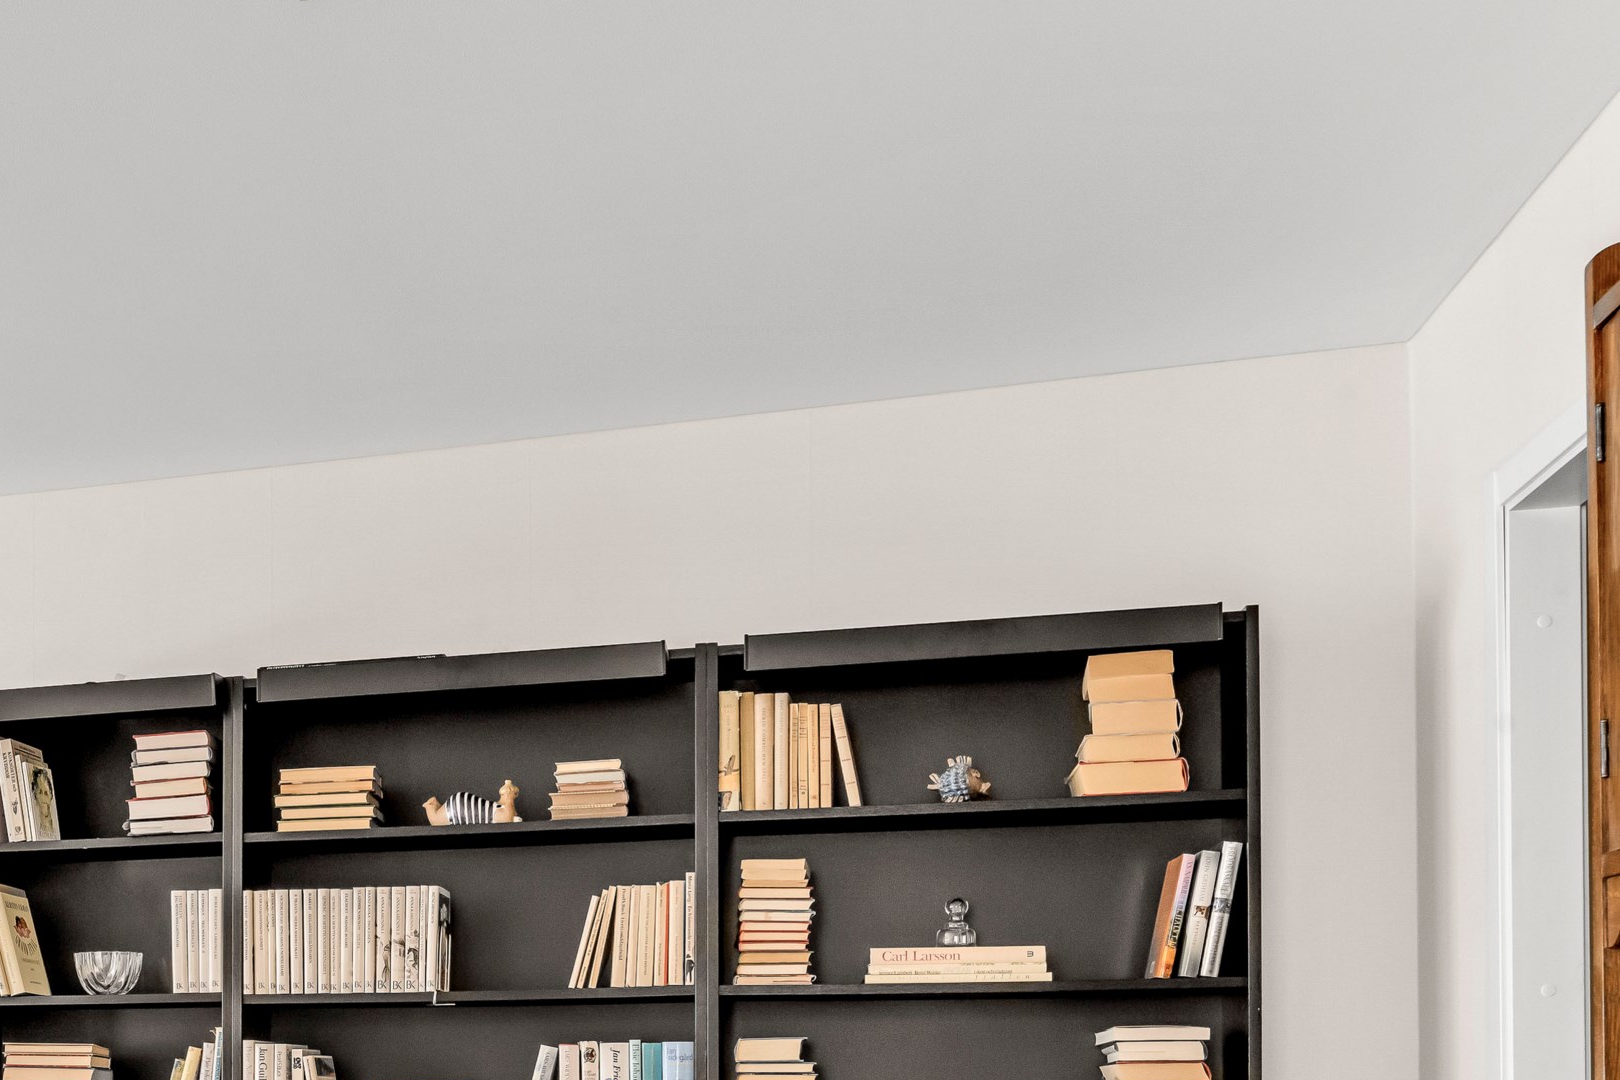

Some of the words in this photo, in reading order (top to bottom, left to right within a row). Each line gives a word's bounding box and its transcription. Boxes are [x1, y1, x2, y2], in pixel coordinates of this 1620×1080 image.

[882, 950, 908, 962] Carl
[913, 950, 961, 961] Larsson
[377, 980, 387, 990] BK
[392, 980, 403, 990] BK
[406, 980, 416, 990] BK
[258, 1046, 268, 1061] Jan
[610, 1047, 621, 1063] Jan
[632, 1044, 640, 1062] Elsie
